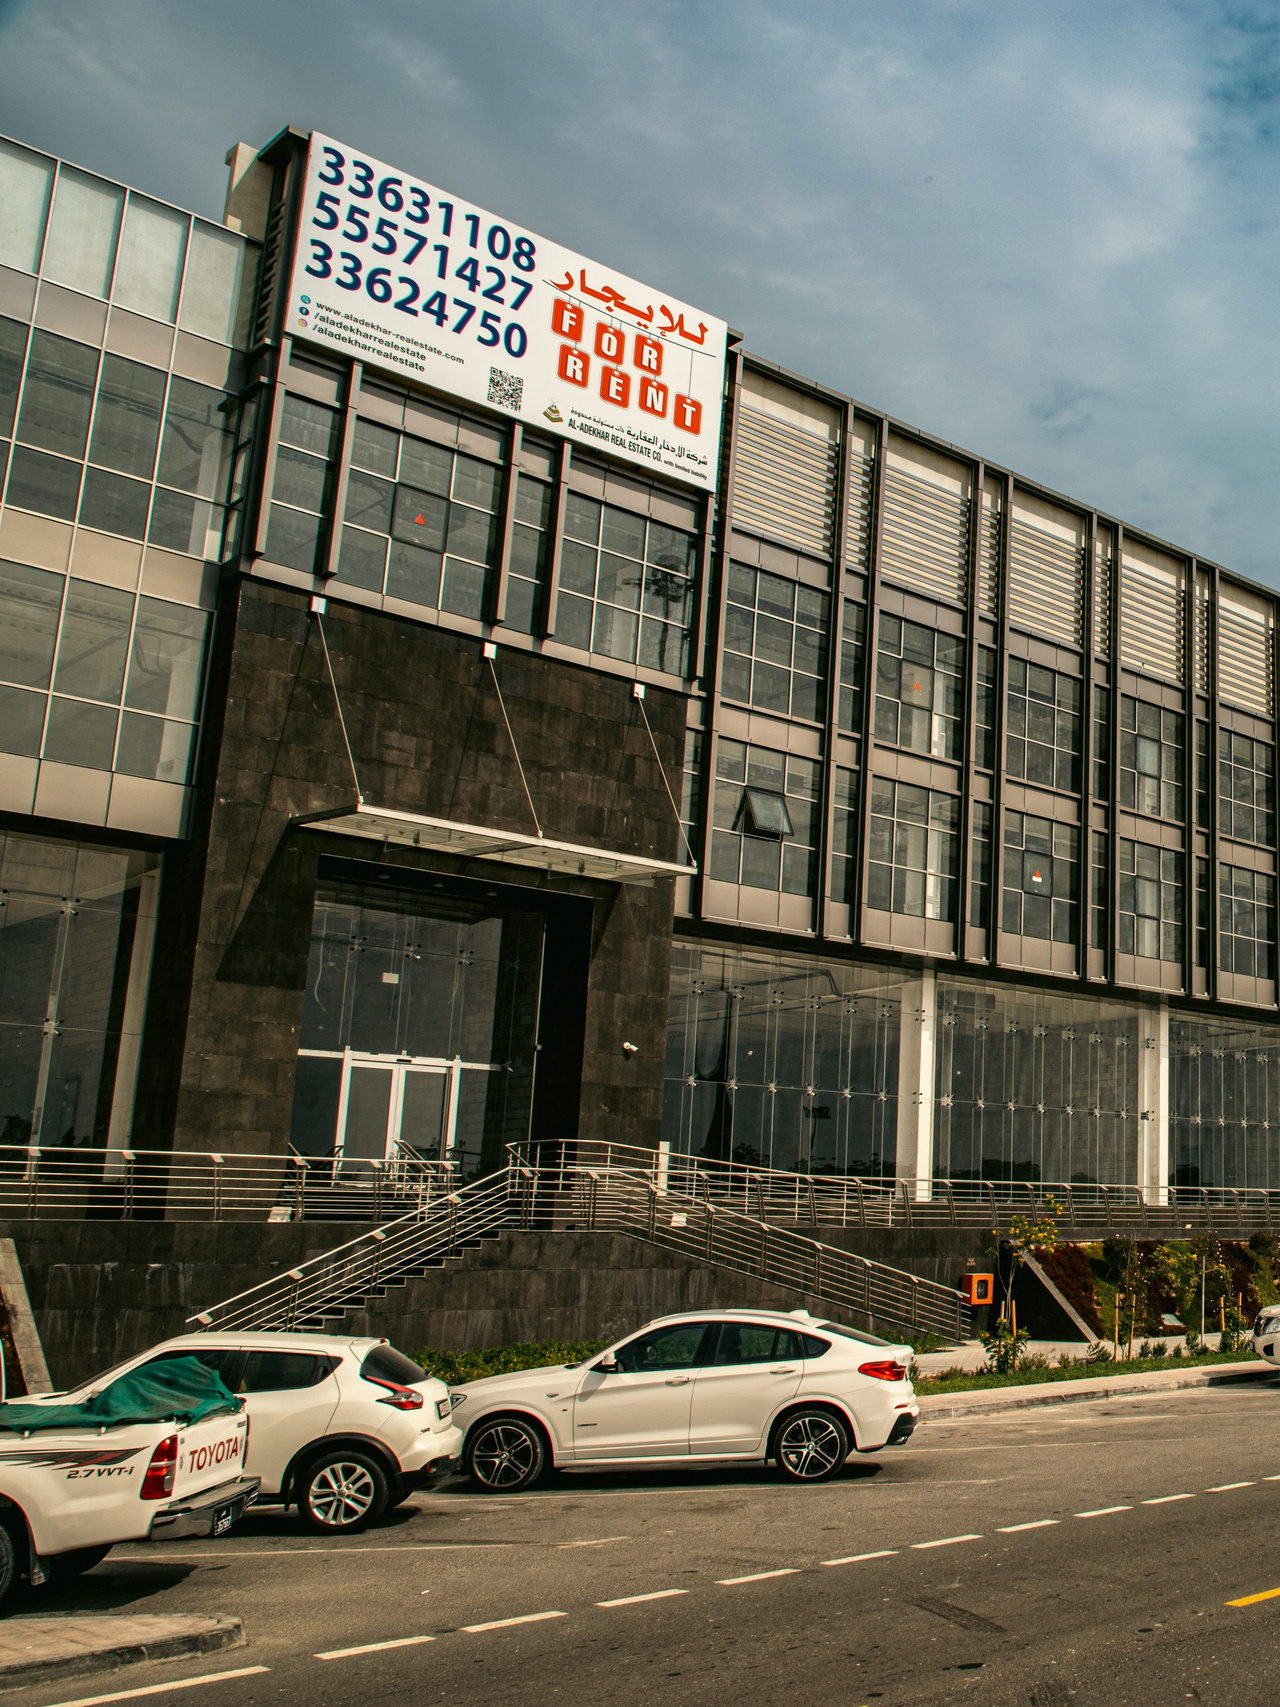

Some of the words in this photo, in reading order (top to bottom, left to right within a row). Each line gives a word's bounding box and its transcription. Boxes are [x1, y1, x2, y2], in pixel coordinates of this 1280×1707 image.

[316, 146, 537, 273] 33631108
[311, 190, 534, 312] 55571427
[304, 238, 528, 359] 33624750
[550, 268, 709, 346] للإيجار
[312, 323, 426, 373] /aladekharrealestate
[314, 312, 427, 362] /aladekharrealestate
[315, 302, 465, 365] www.aladekhar-realestate.com
[561, 309, 659, 371] FOR
[565, 353, 696, 429] RENT
[567, 417, 610, 443] AL-ADEKHAR
[610, 433, 628, 450] REAL
[628, 440, 652, 459] ESTATE
[652, 450, 663, 463] CO.
[663, 459, 675, 468] with
[674, 463, 691, 474] limited
[690, 469, 708, 481] liability
[626, 425, 659, 447] العقارية
[685, 448, 708, 466] شركة
[66, 1469, 96, 1479] 2.7
[97, 1466, 135, 1477] VVT-i
[189, 1436, 238, 1474] TOYOTA
